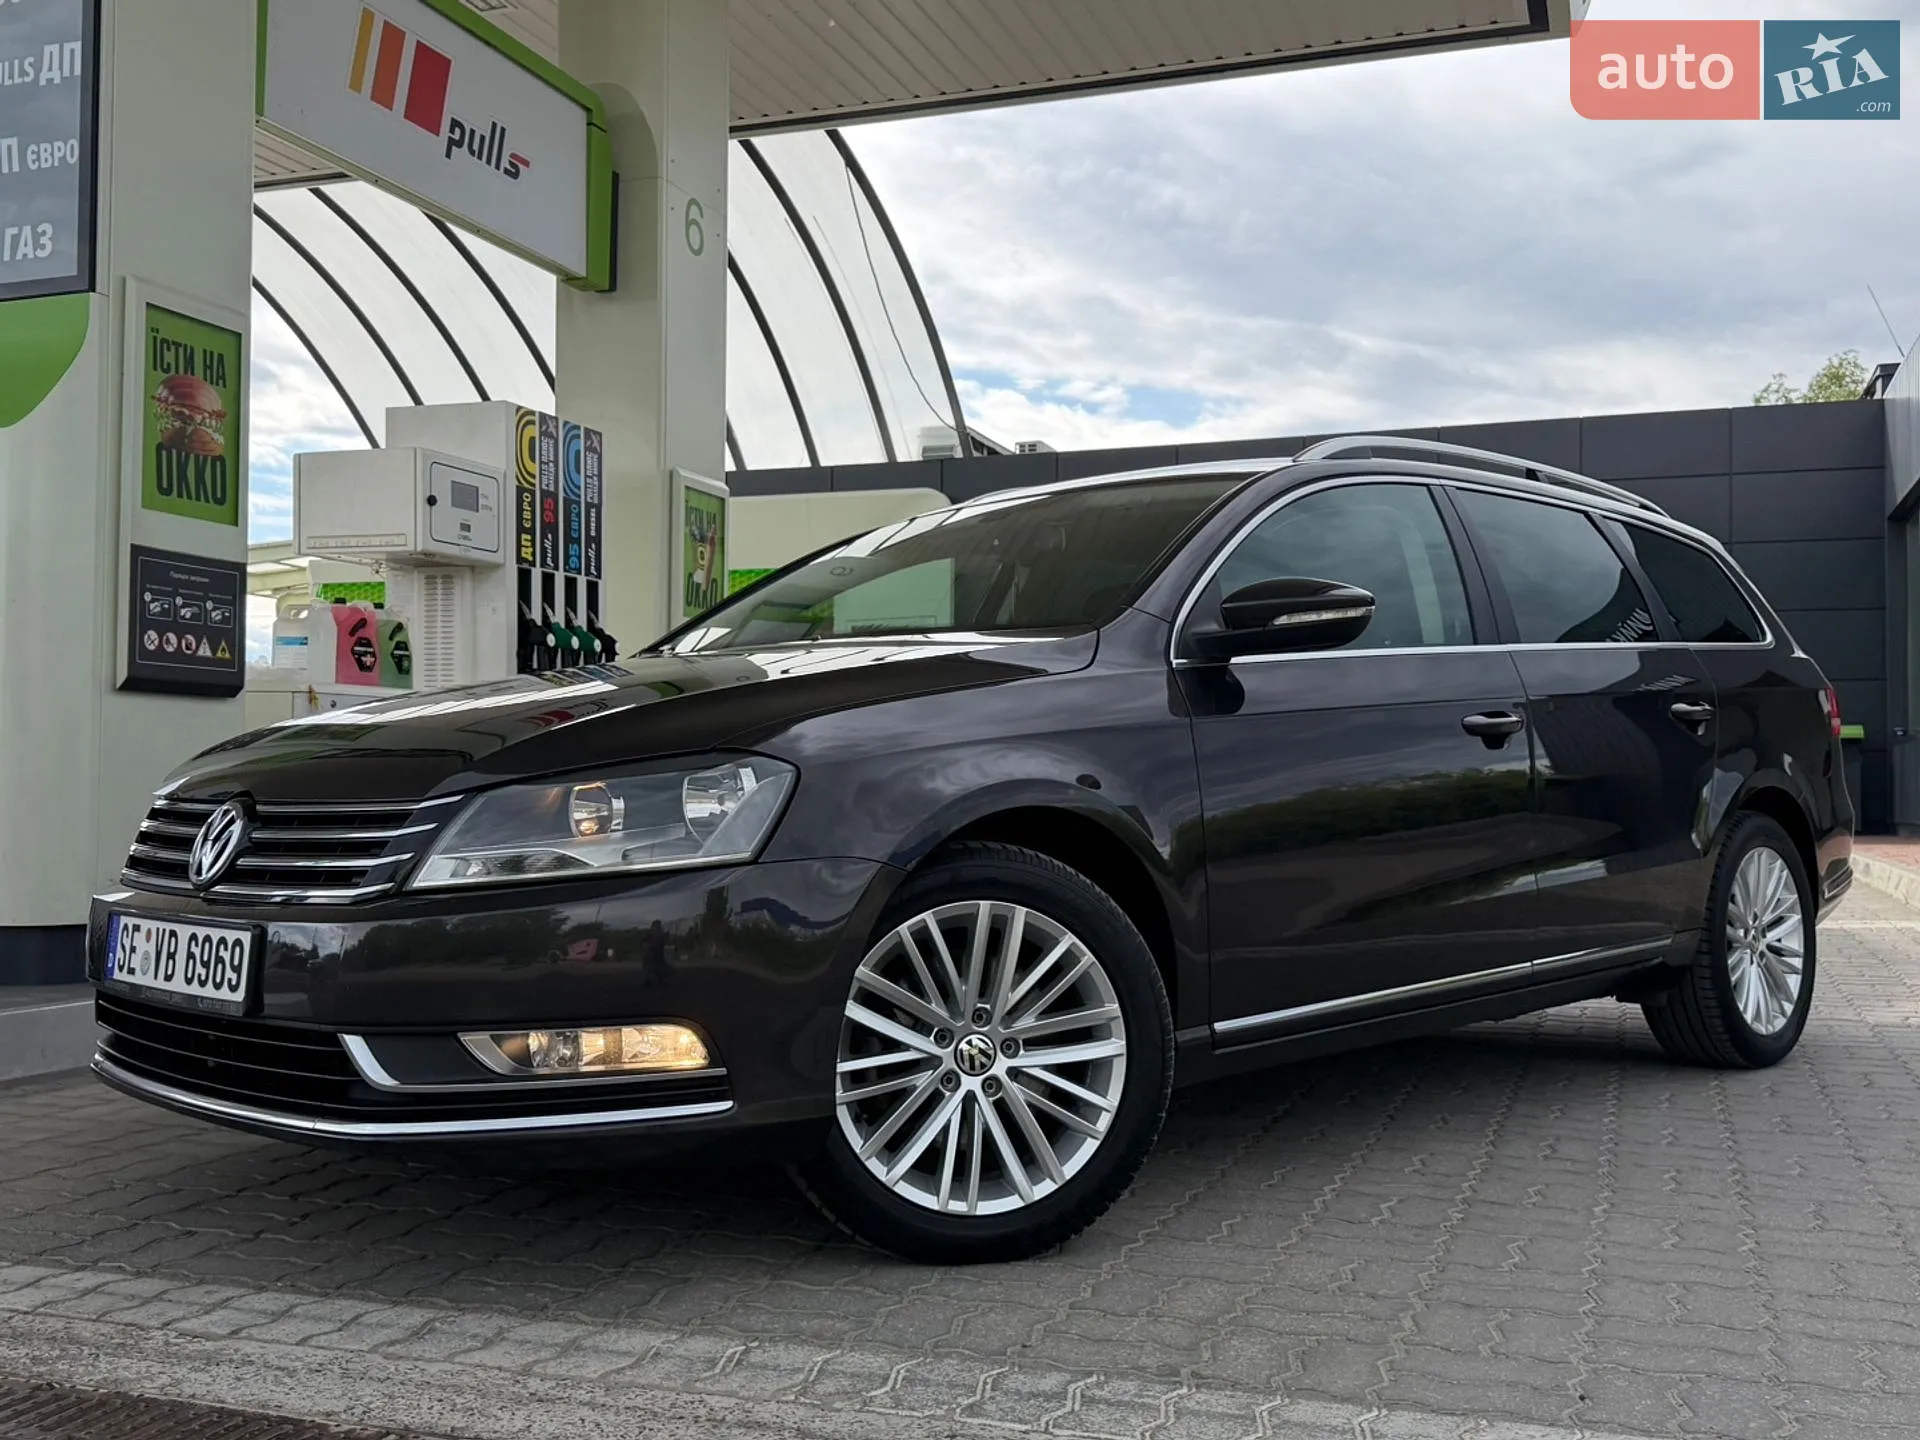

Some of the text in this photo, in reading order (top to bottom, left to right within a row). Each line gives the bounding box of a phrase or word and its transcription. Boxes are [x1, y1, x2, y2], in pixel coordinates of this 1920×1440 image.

[0, 40, 82, 86] LLS ДП
[444, 116, 531, 181] pulls
[3, 222, 54, 262] ГАЗ
[684, 197, 705, 257] 6
[150, 327, 228, 389] ЇСТИ НА
[543, 497, 555, 523] 95
[520, 533, 534, 561] ДП
[568, 543, 580, 569] 95
[118, 922, 244, 993] SE VB 6969
